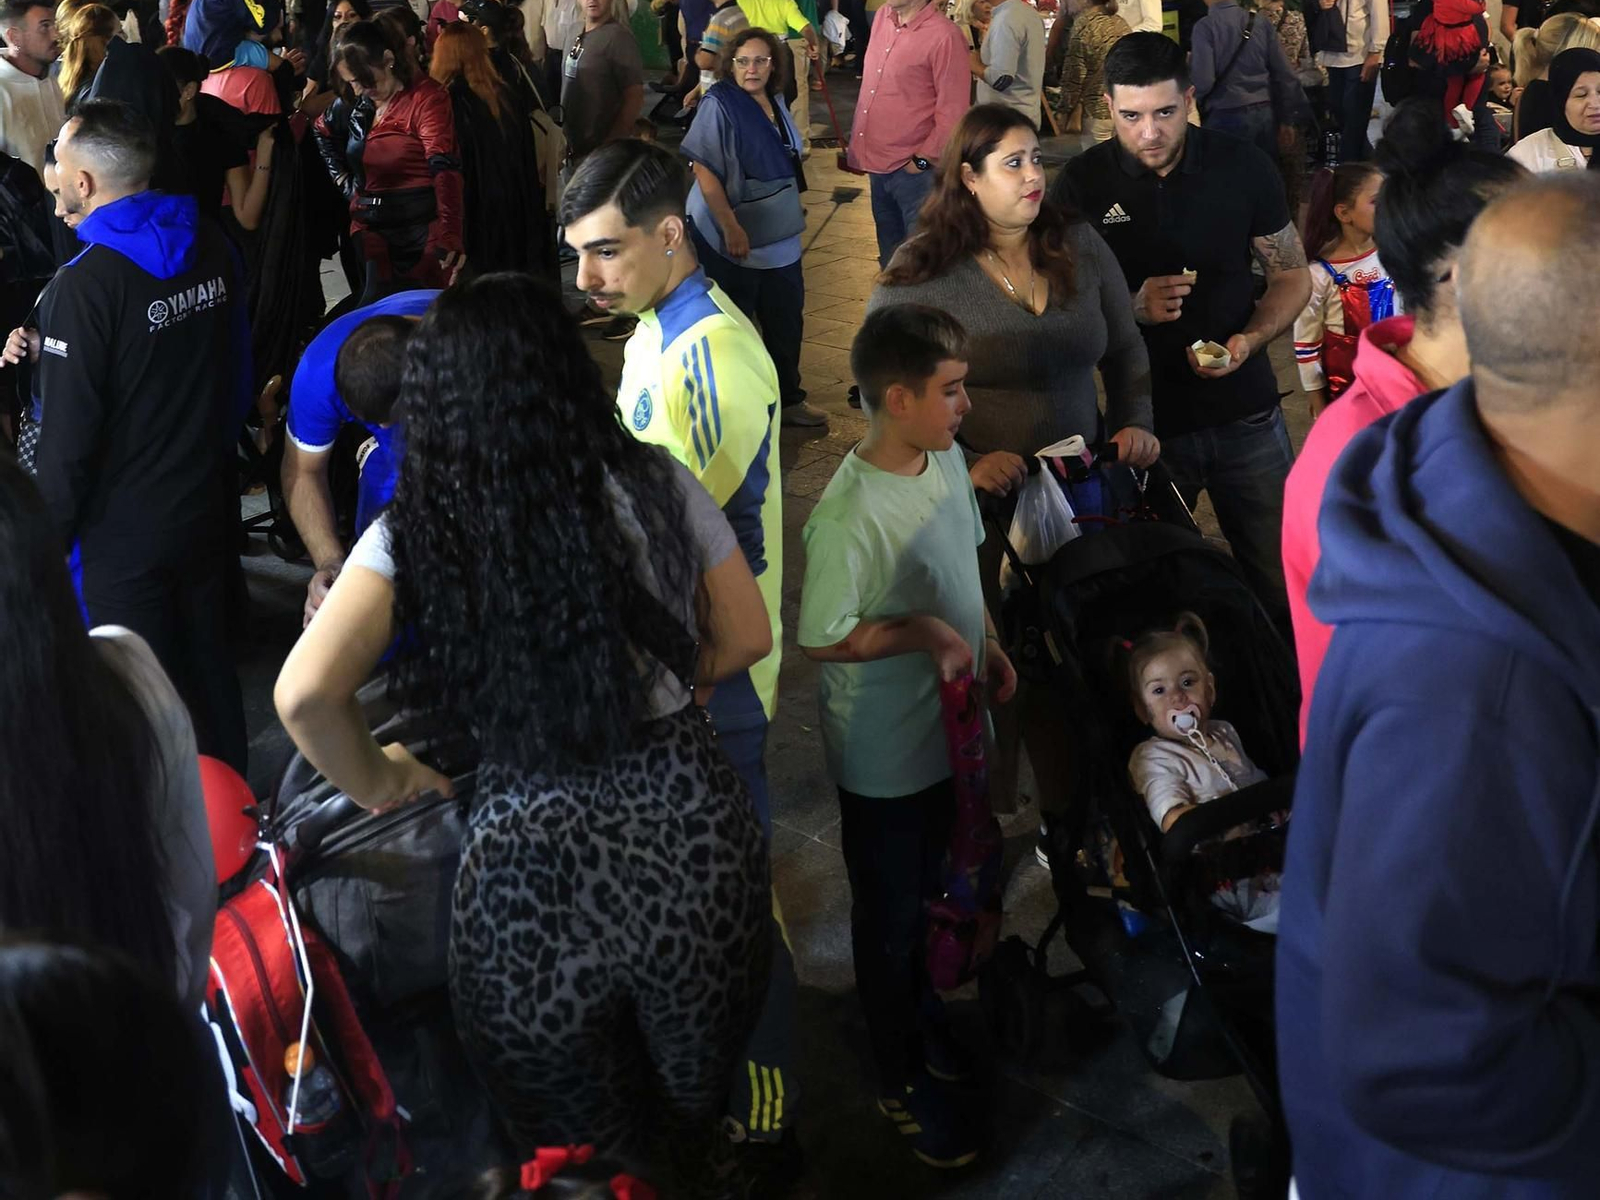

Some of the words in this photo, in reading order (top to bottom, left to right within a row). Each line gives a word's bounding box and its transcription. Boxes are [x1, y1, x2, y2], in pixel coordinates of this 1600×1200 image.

[1102, 215, 1131, 225] adidas
[167, 276, 227, 316] YAMAHA
[195, 295, 227, 313] RACNG
